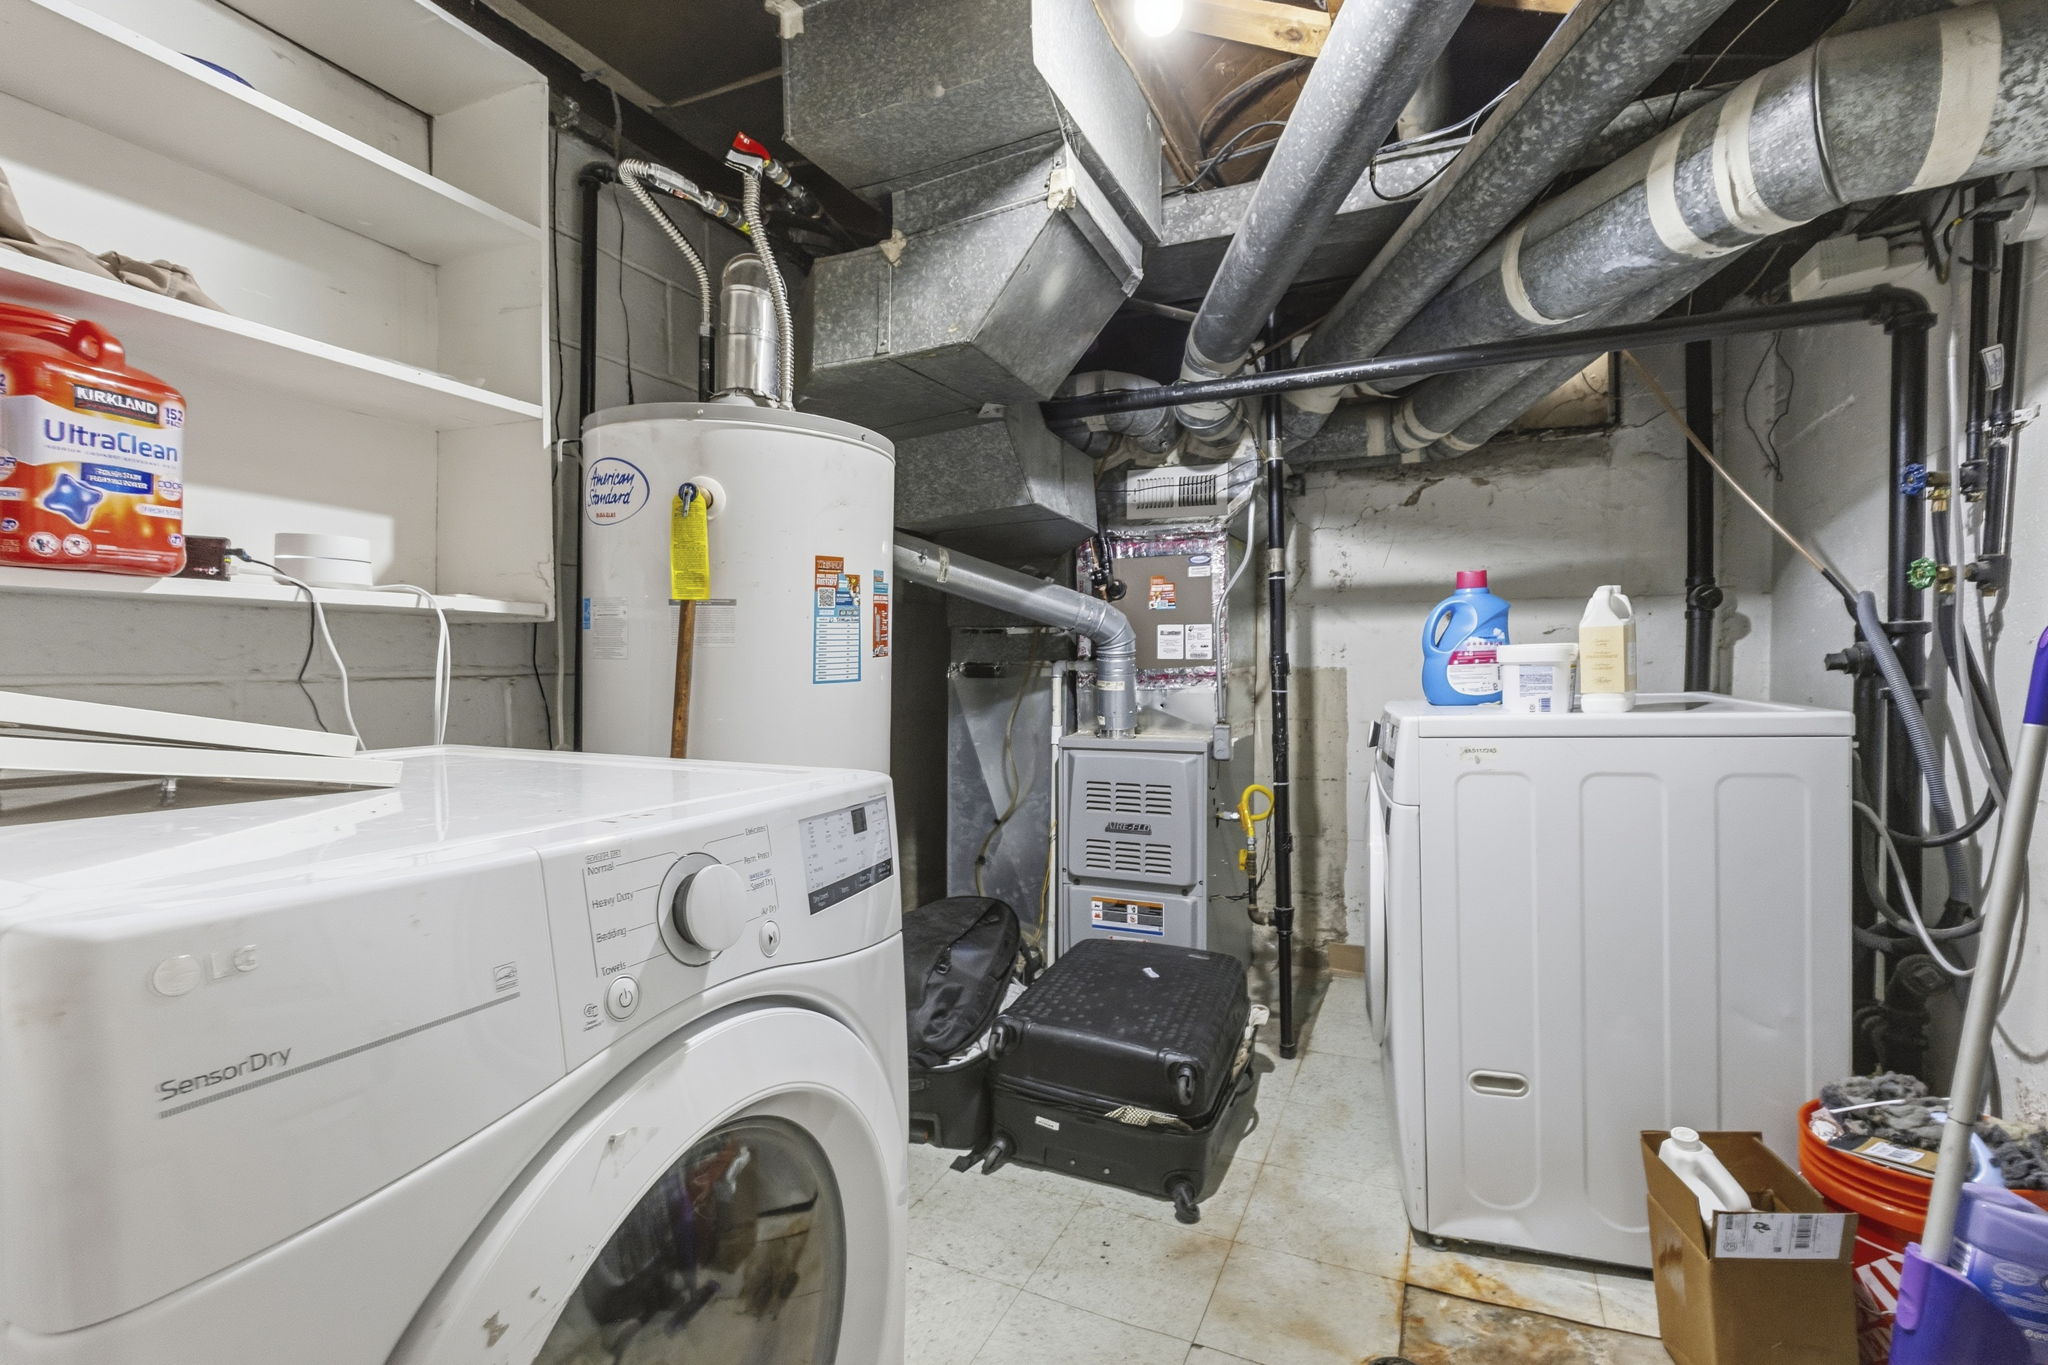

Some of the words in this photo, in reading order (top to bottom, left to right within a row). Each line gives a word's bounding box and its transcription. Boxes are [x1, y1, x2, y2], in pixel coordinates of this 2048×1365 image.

[77, 386, 159, 415] KIRKLAND
[165, 407, 184, 422] 152
[44, 418, 178, 462] UltraClean
[591, 466, 635, 487] American
[588, 486, 634, 507] Standard
[587, 861, 615, 876] Normal
[592, 896, 615, 909] Heavy
[616, 891, 634, 902] Duty
[596, 928, 627, 943] Bedding
[205, 943, 259, 985] LG
[601, 961, 627, 977] Towels
[159, 1047, 292, 1102] SensorDry
